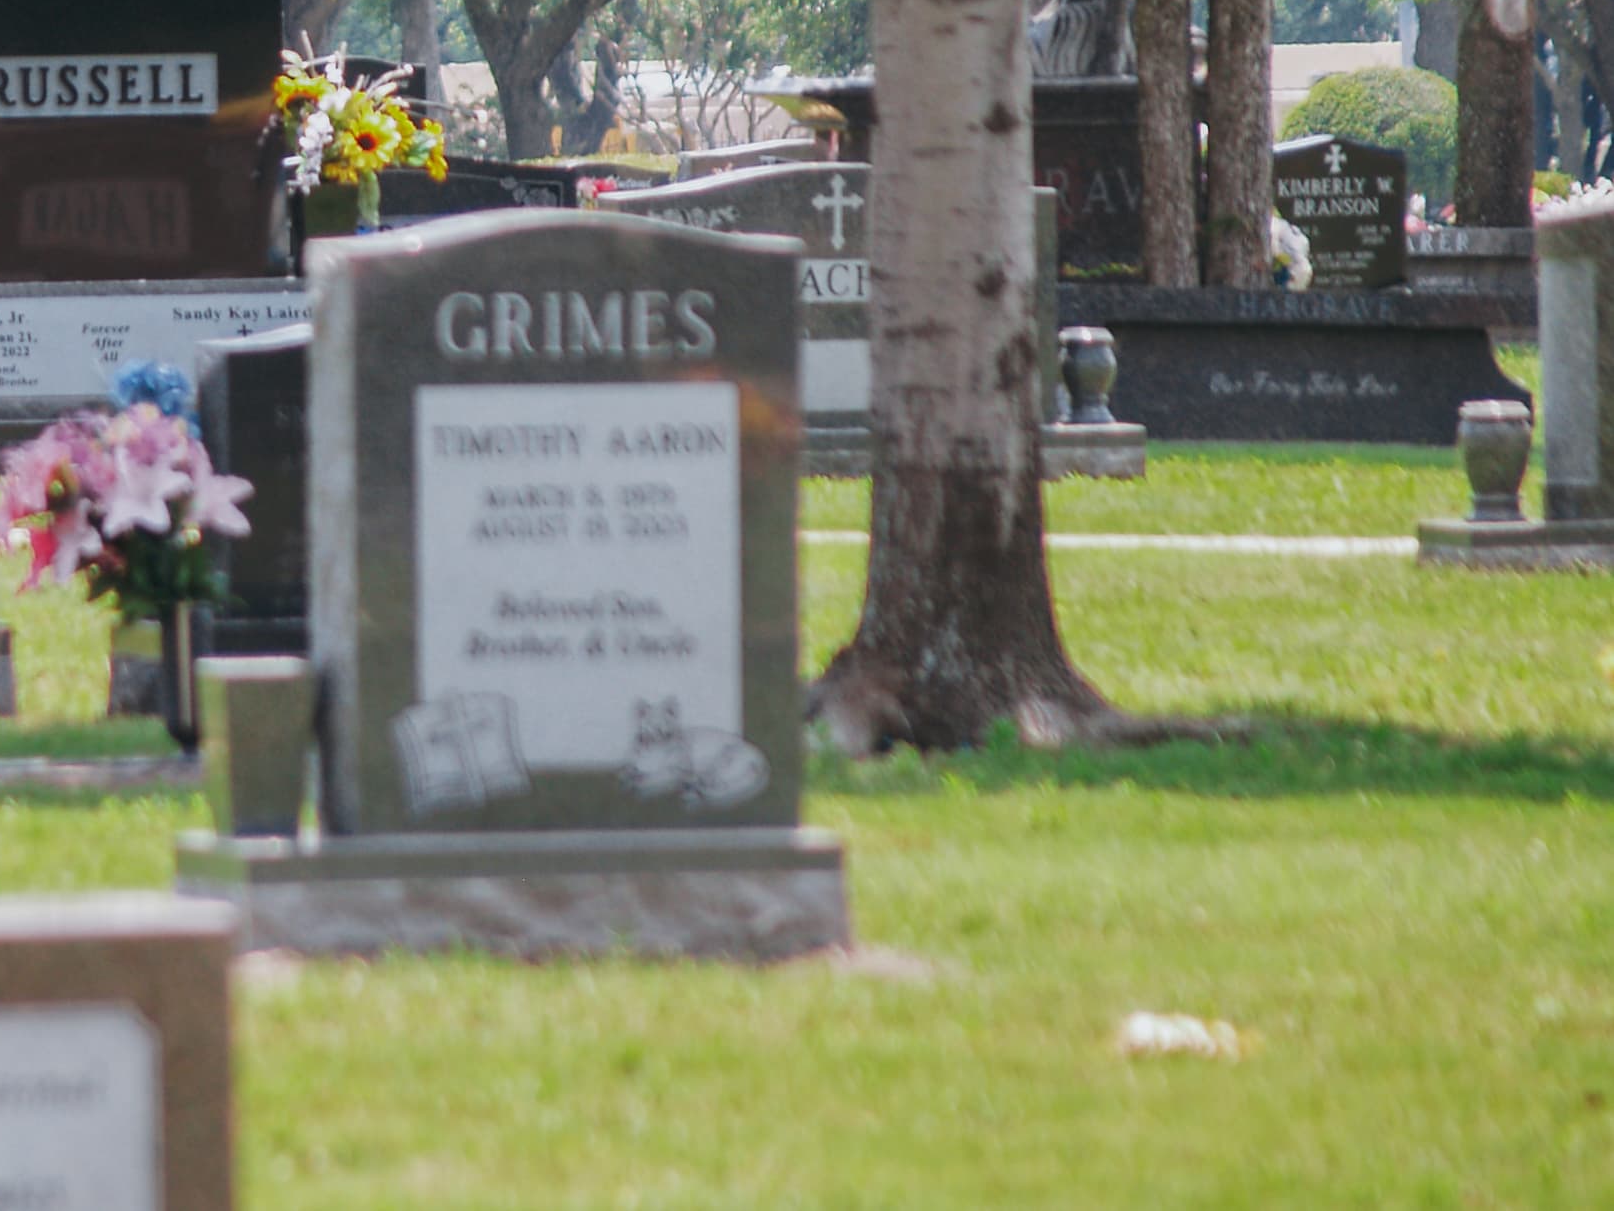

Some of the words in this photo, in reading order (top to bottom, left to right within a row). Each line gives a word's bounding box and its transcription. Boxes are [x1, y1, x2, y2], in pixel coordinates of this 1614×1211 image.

[1277, 176, 1366, 198] KIMBERLY
[1293, 197, 1380, 217] BRANSON
[172, 306, 223, 323] Sandy
[229, 305, 260, 322] Kay
[1238, 293, 1393, 320] HARGRAVE
[81, 321, 132, 335] Forever
[433, 288, 718, 359] GRIMES
[1, 345, 31, 358] 2022
[92, 336, 125, 351] After
[100, 350, 120, 363] All
[431, 423, 585, 459] TIMOTHY
[607, 421, 728, 458] AARON
